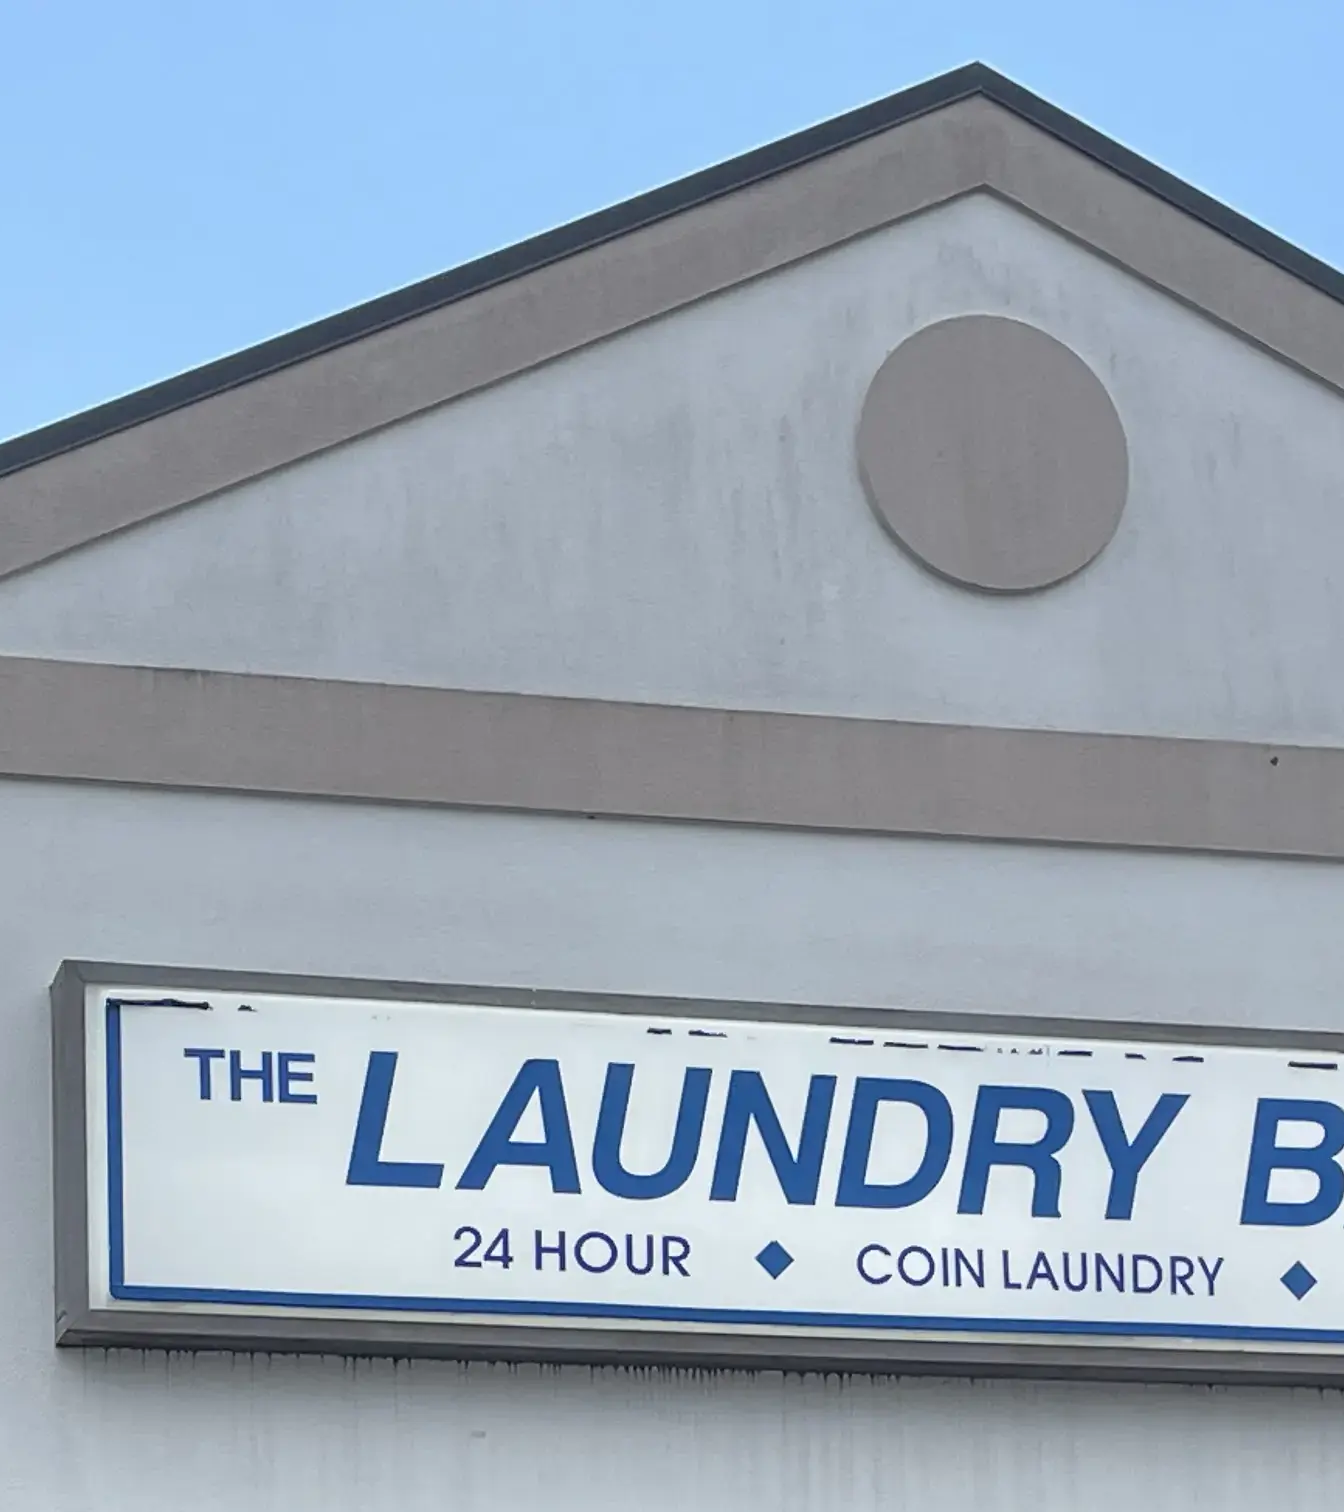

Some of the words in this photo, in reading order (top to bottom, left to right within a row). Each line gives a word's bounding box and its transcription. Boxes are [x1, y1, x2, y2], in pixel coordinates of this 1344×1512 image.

[184, 1048, 317, 1105] THE
[346, 1050, 1191, 1221] LAUNDRY
[454, 1226, 514, 1269] 24
[535, 1230, 691, 1277] HOUR
[857, 1244, 985, 1288] COIN
[1003, 1250, 1225, 1297] LAUNDRY
